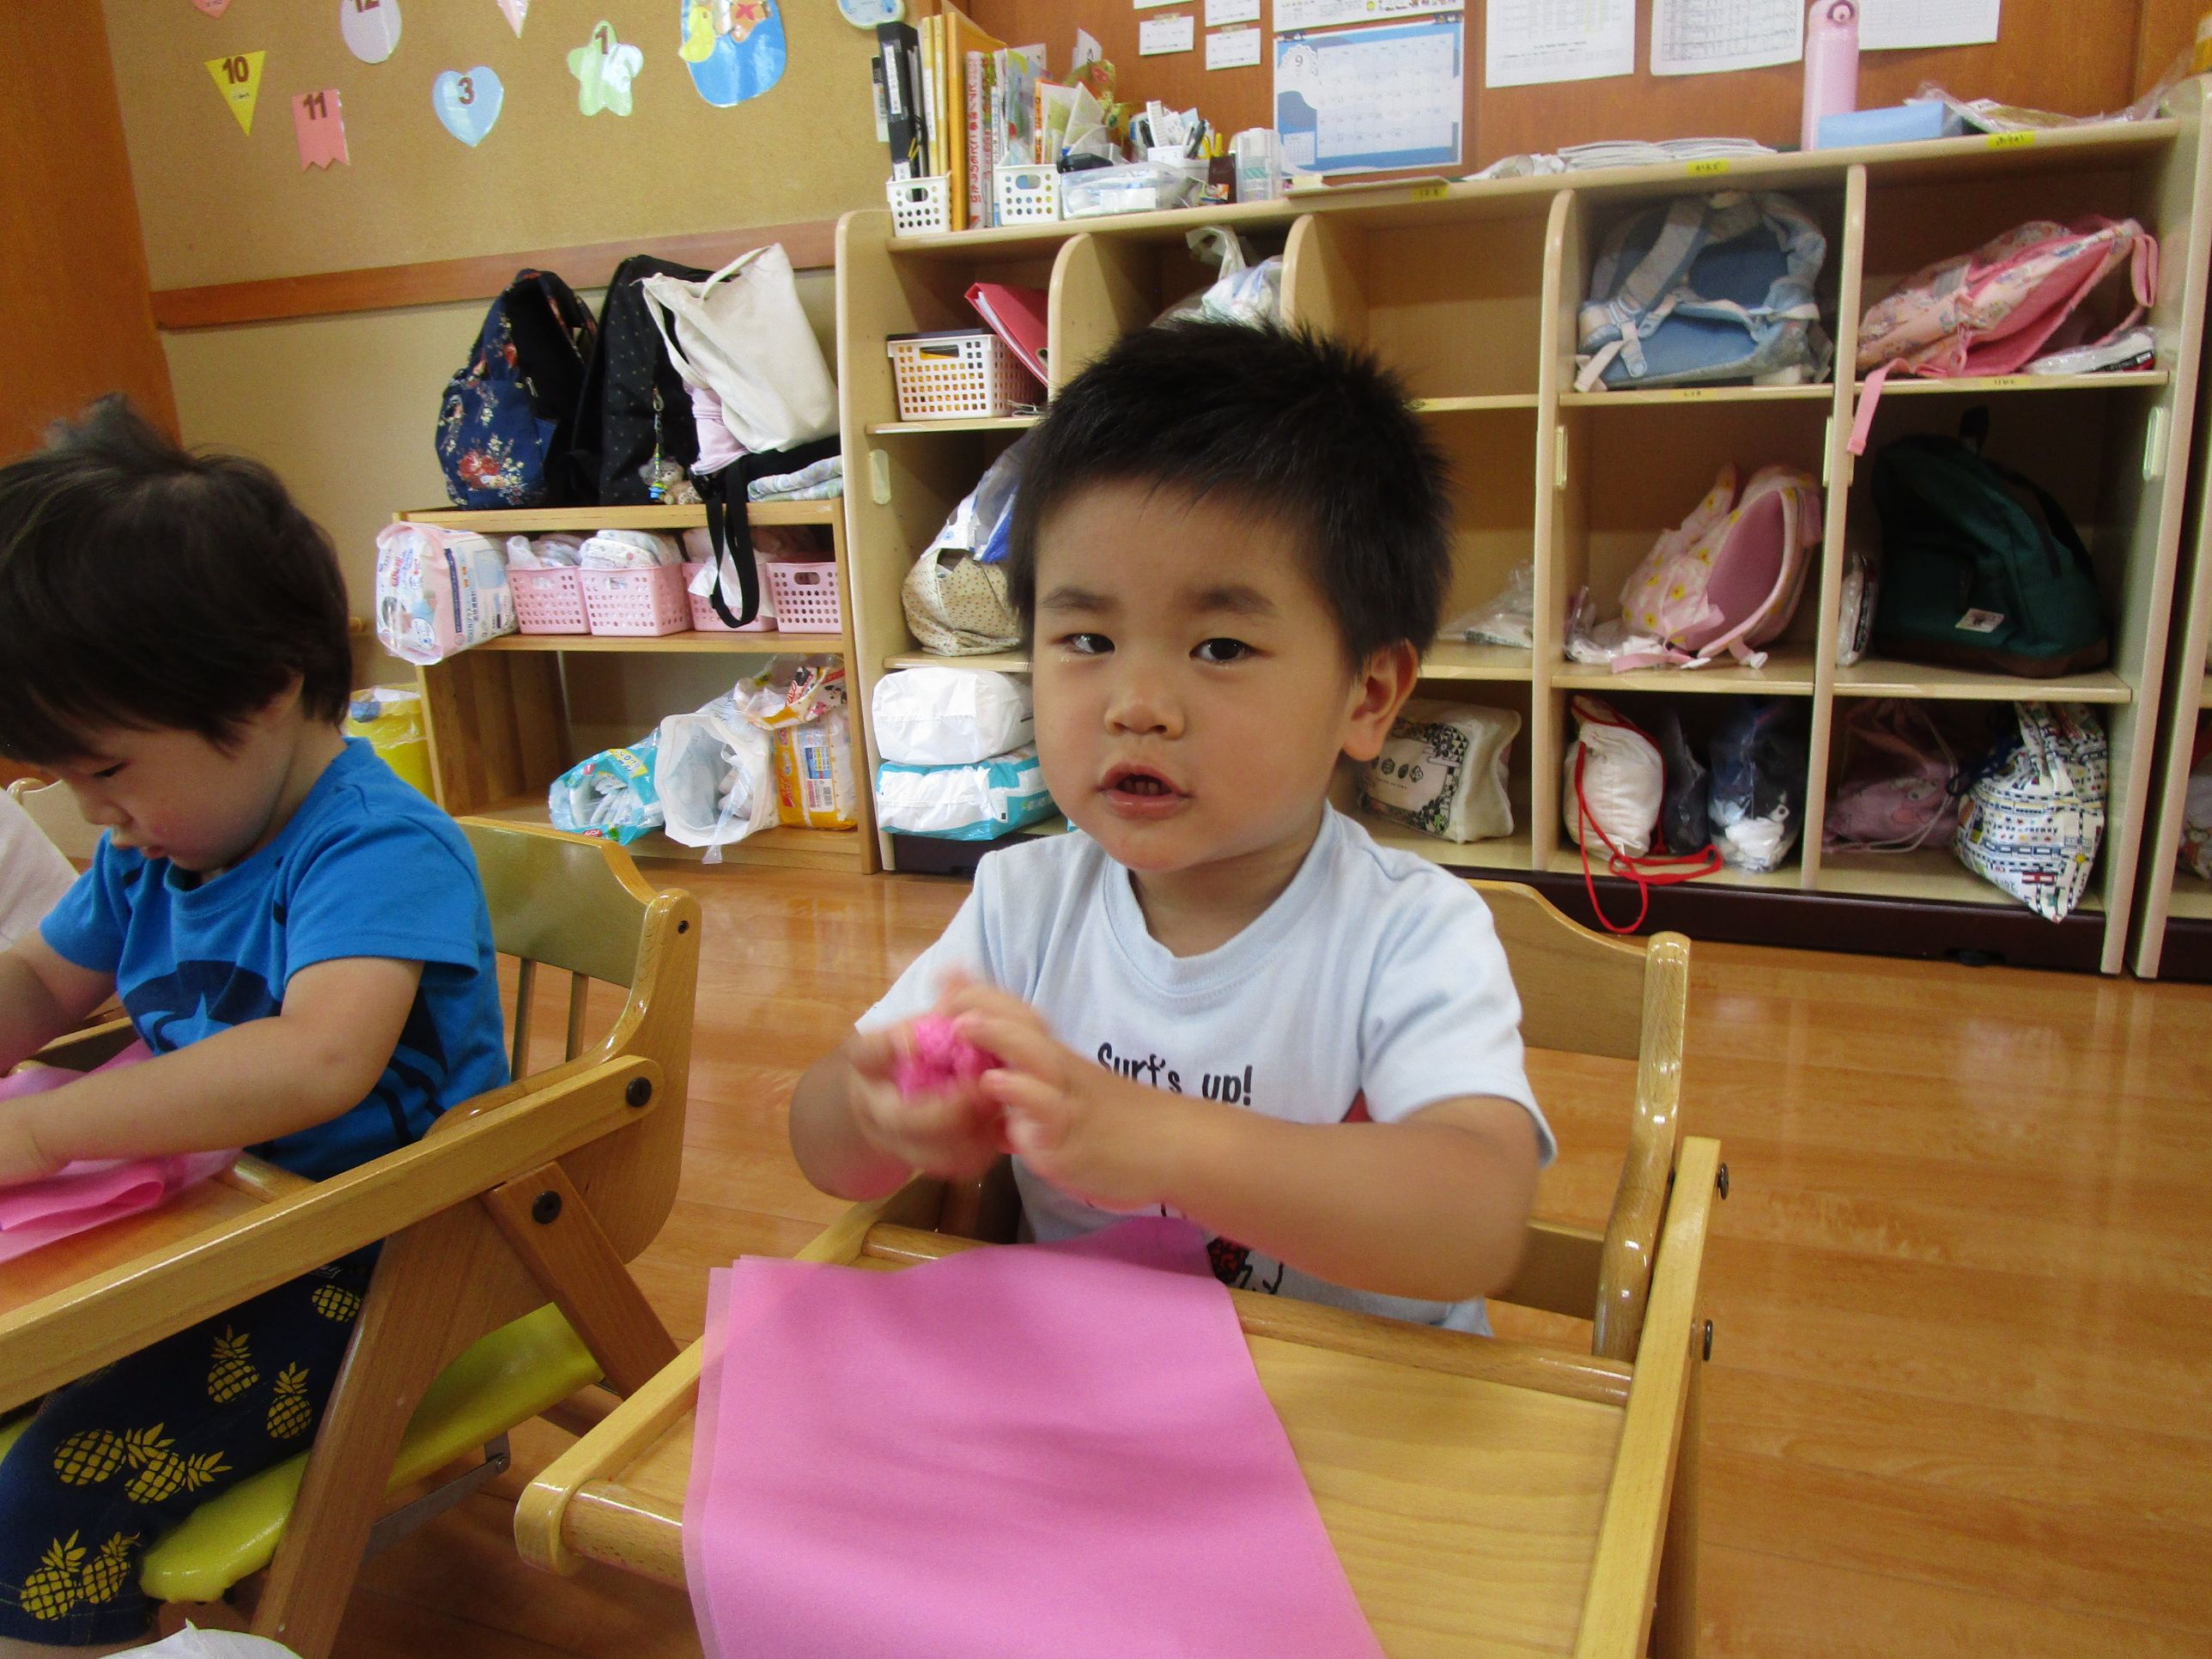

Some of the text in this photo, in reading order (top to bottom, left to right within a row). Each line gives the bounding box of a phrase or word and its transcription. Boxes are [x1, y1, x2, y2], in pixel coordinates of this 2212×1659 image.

[595, 26, 608, 54] 1
[222, 56, 249, 84] 10
[1294, 54, 1304, 67] 9
[459, 76, 475, 105] 3
[303, 93, 328, 119] 11
[1097, 1042, 1253, 1106] Surf's up!
